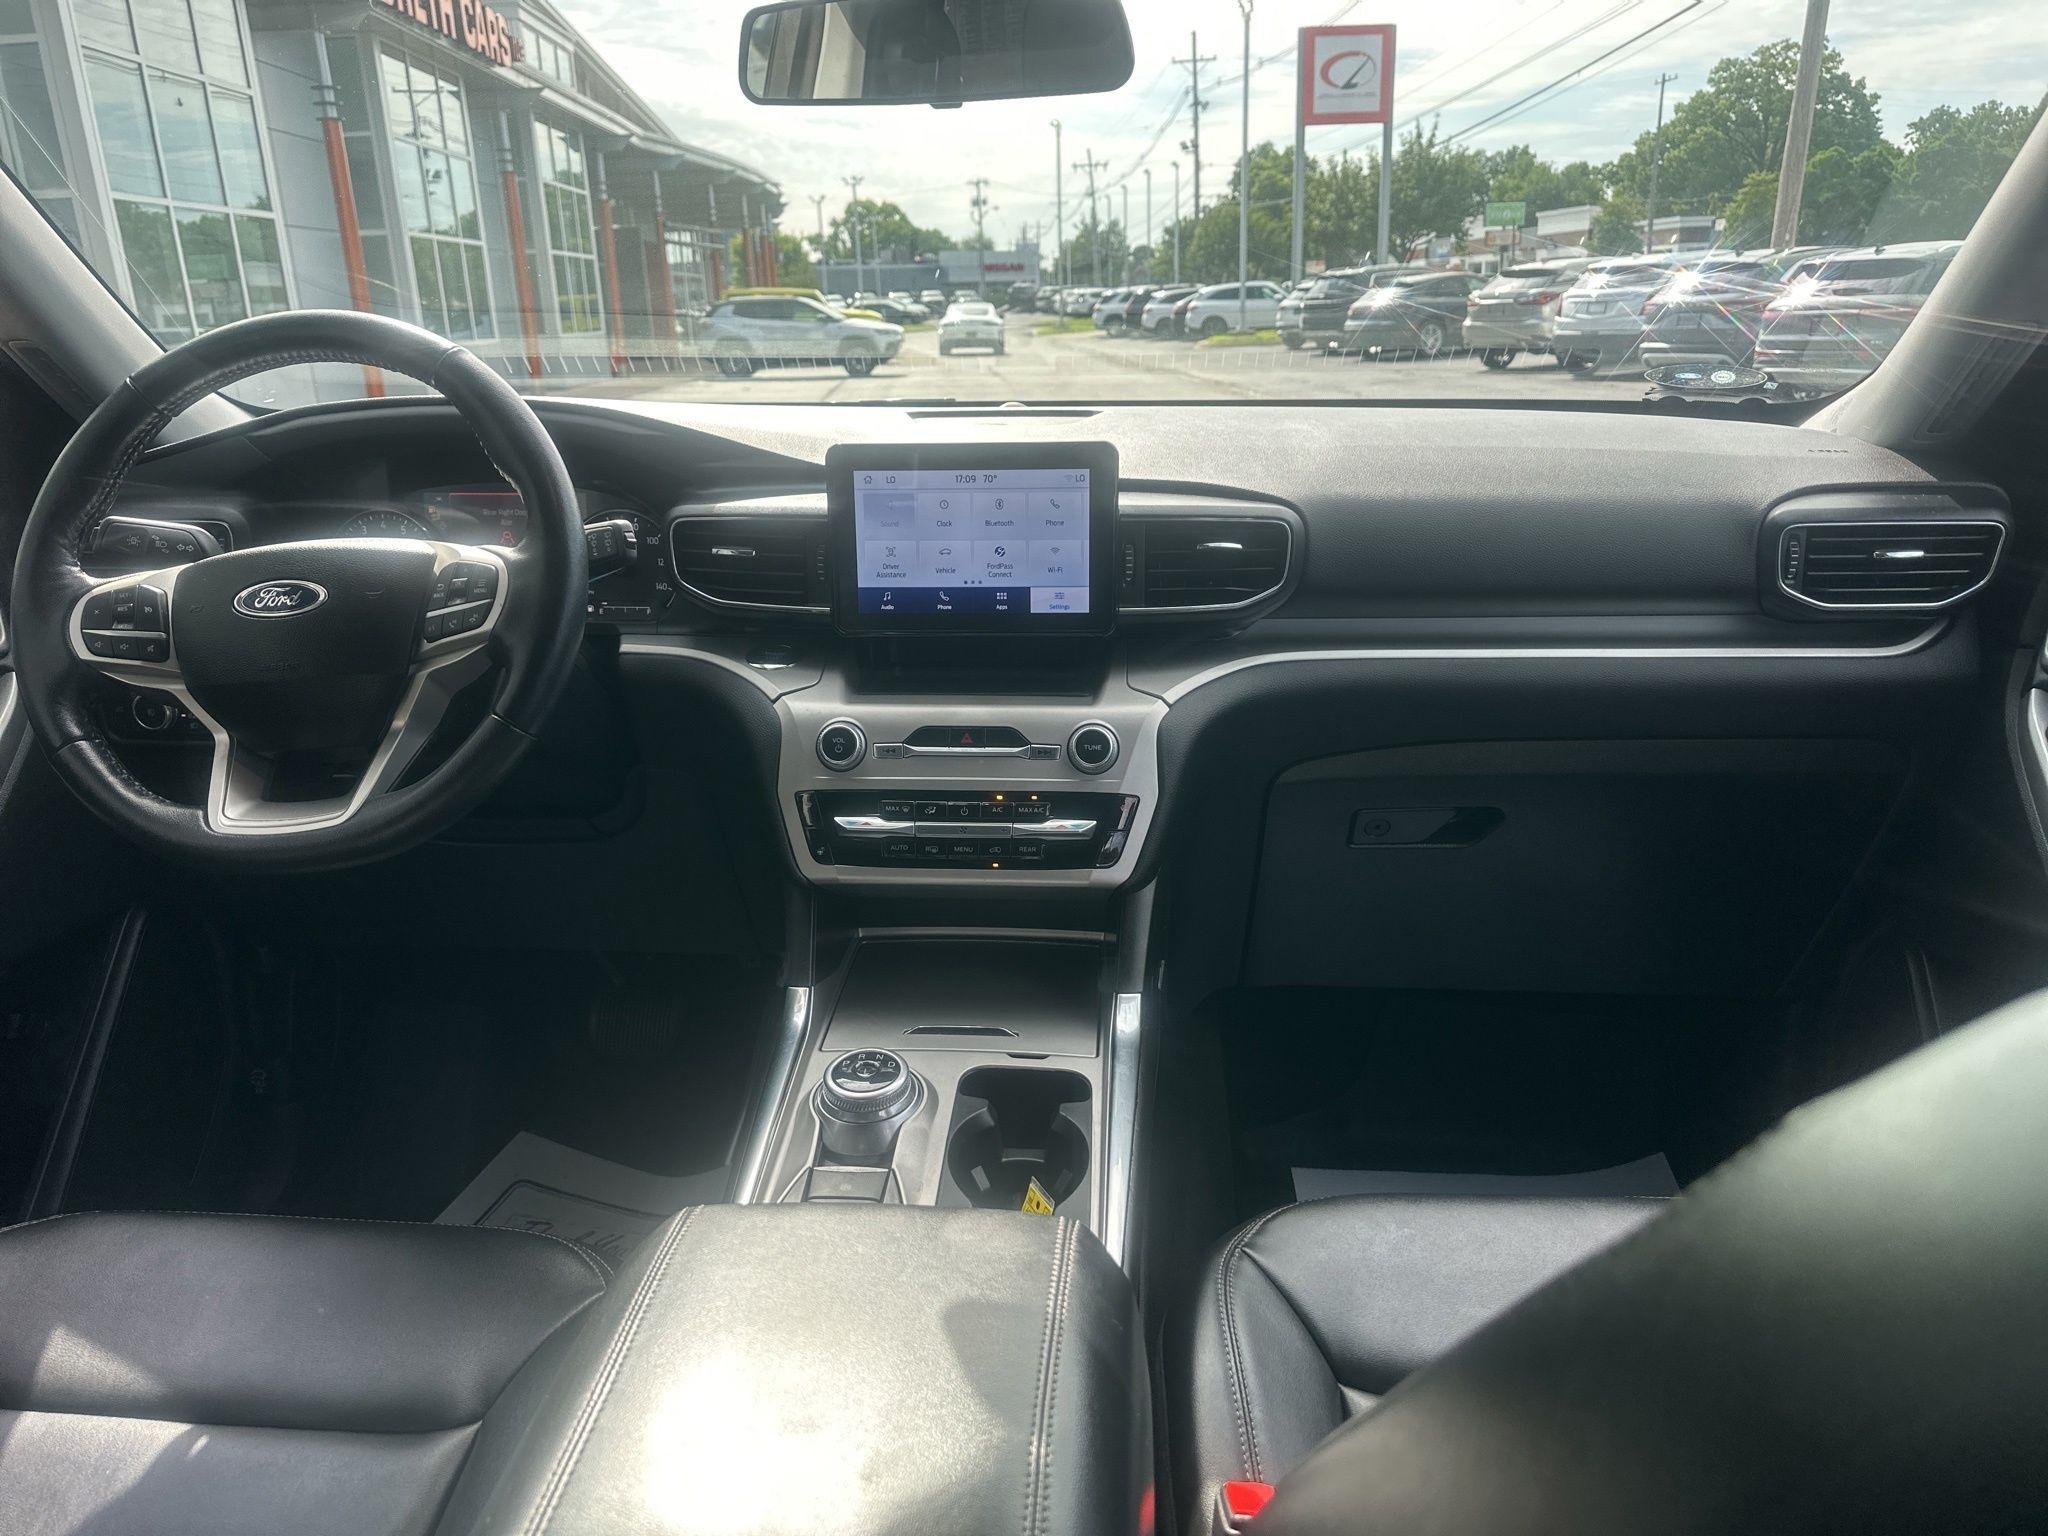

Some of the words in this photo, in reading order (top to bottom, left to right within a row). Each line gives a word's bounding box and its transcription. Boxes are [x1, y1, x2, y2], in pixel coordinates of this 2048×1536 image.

[459, 0, 512, 68] CARS
[886, 476, 896, 484] LO
[955, 475, 976, 484] 17:09
[983, 475, 998, 483] 70°
[1075, 474, 1086, 483] LO
[936, 520, 953, 528] Clock
[985, 519, 1015, 527] Bluetooth
[1045, 519, 1065, 527] Phone
[361, 525, 368, 535] 3
[646, 536, 660, 545] 100
[882, 562, 900, 571] Driver
[986, 562, 1014, 570] FordPass
[1047, 566, 1064, 574] Wi-Fi
[876, 571, 907, 579] Assistance
[935, 567, 957, 575] Vehicle
[656, 582, 668, 590] 140
[254, 587, 302, 608] Ford
[1049, 603, 1071, 611] Settings
